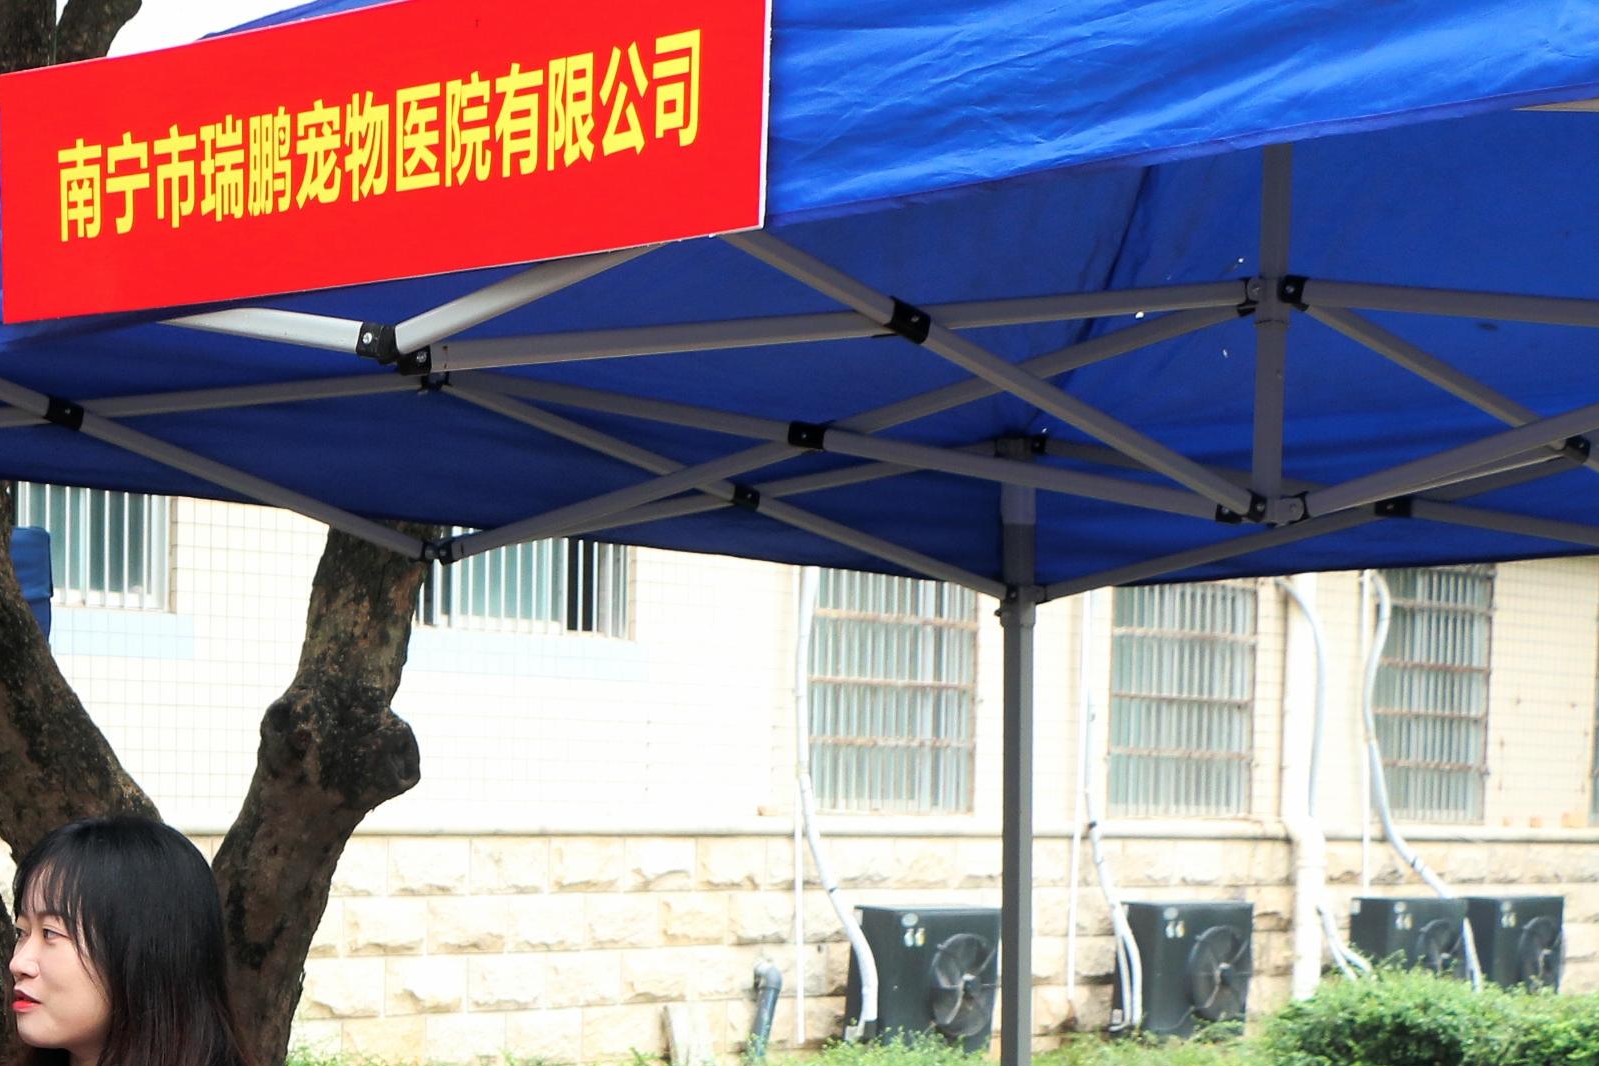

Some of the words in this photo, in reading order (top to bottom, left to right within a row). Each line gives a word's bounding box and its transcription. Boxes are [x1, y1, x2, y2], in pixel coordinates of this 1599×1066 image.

[57, 29, 702, 243] 南宁市瑞鹏宠物医院有限公司
